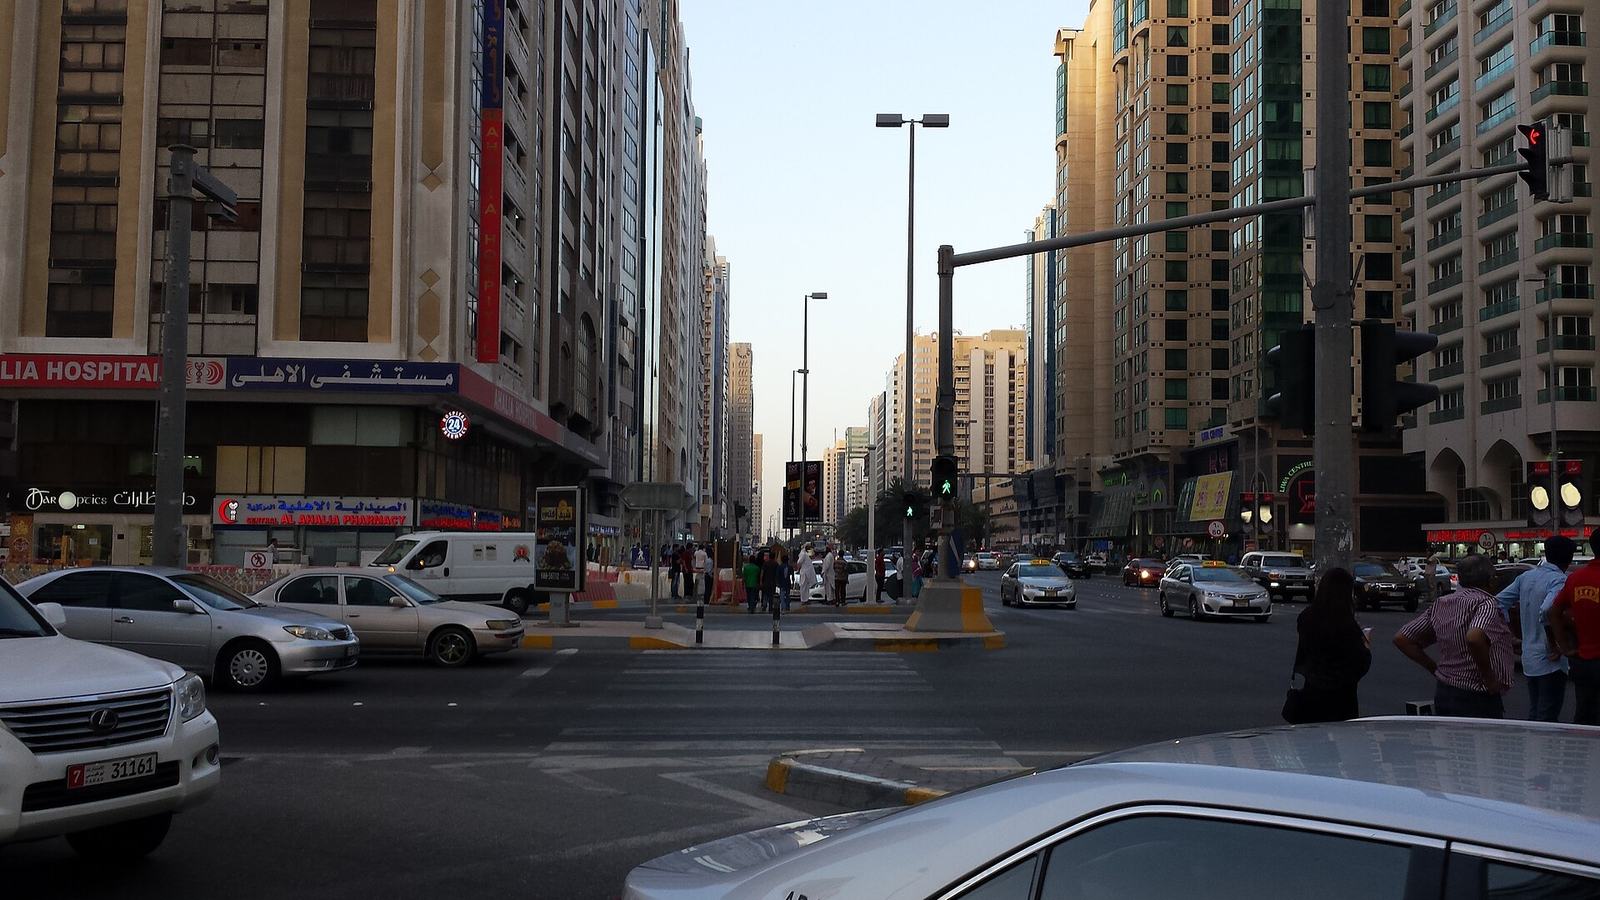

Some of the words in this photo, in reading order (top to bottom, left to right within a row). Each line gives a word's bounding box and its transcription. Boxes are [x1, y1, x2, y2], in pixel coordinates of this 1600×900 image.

[448, 419, 461, 430] 24
[281, 514, 295, 525] AL
[343, 515, 406, 525] PHARMACY
[73, 769, 81, 784] 7
[111, 757, 154, 779] 31161
